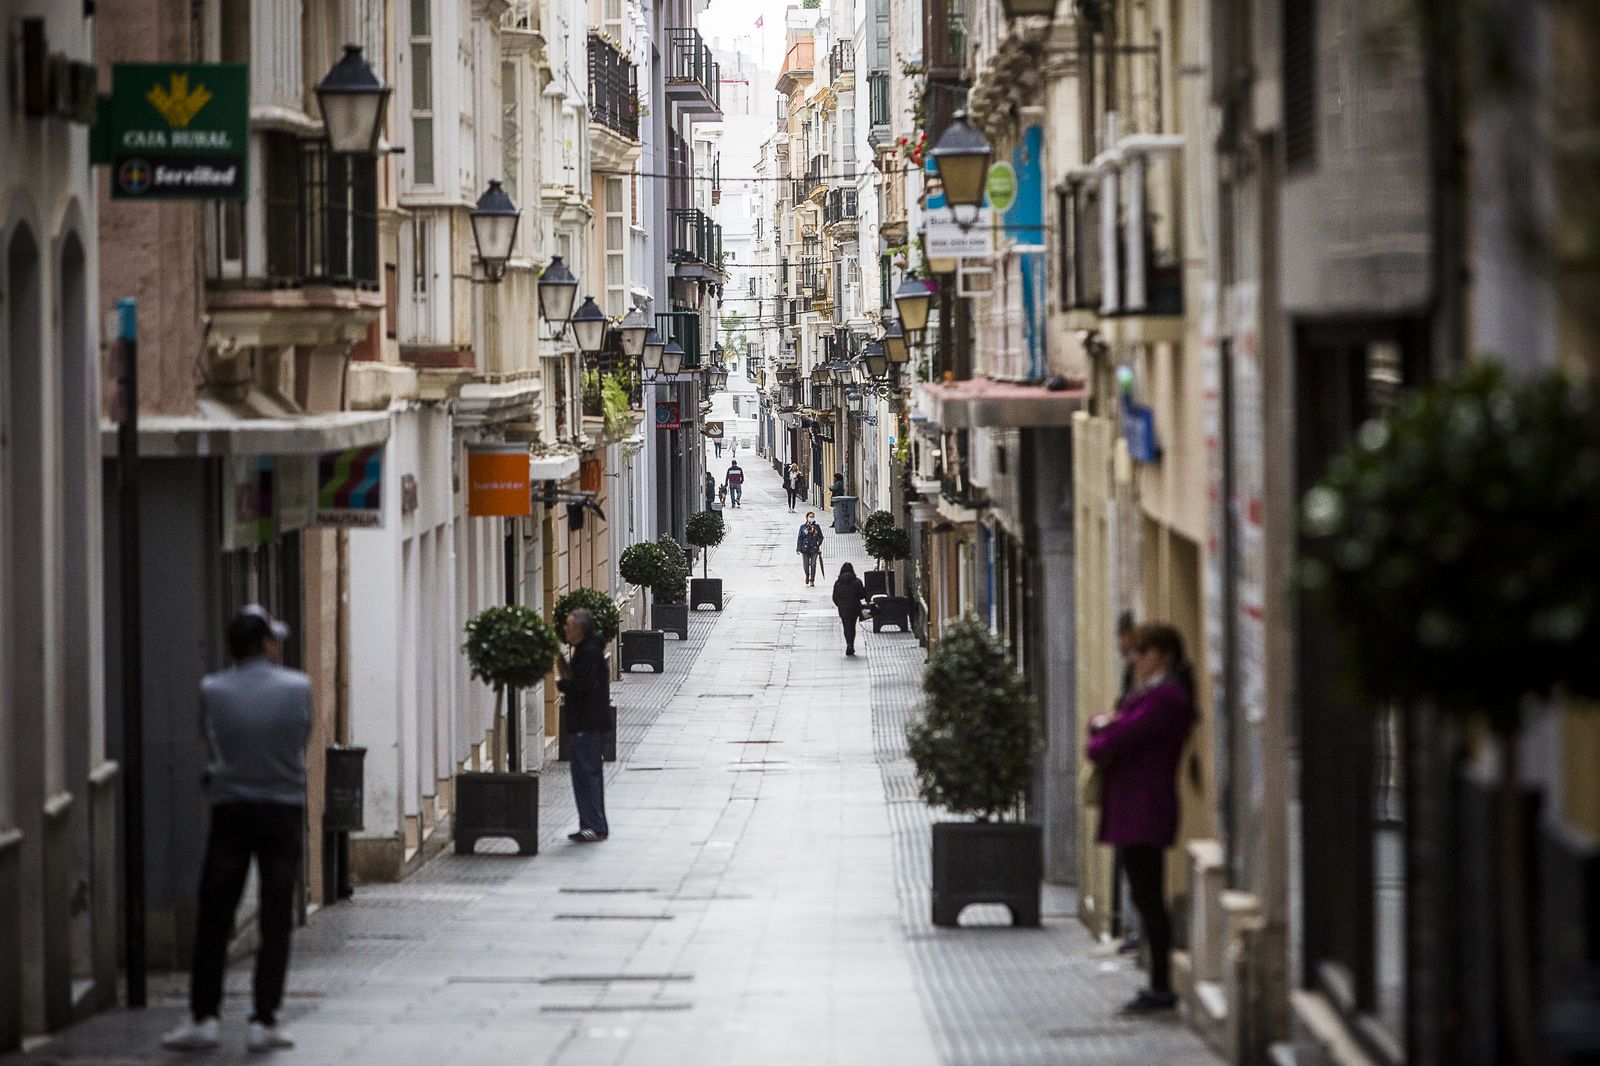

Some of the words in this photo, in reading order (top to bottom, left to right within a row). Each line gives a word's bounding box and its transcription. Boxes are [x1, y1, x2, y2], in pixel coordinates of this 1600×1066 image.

[122, 130, 168, 149] CAJA
[171, 130, 233, 149] RURAL
[154, 165, 236, 186] ServiRed
[473, 480, 525, 491] bankinter
[315, 512, 379, 526] NAUTALIA
